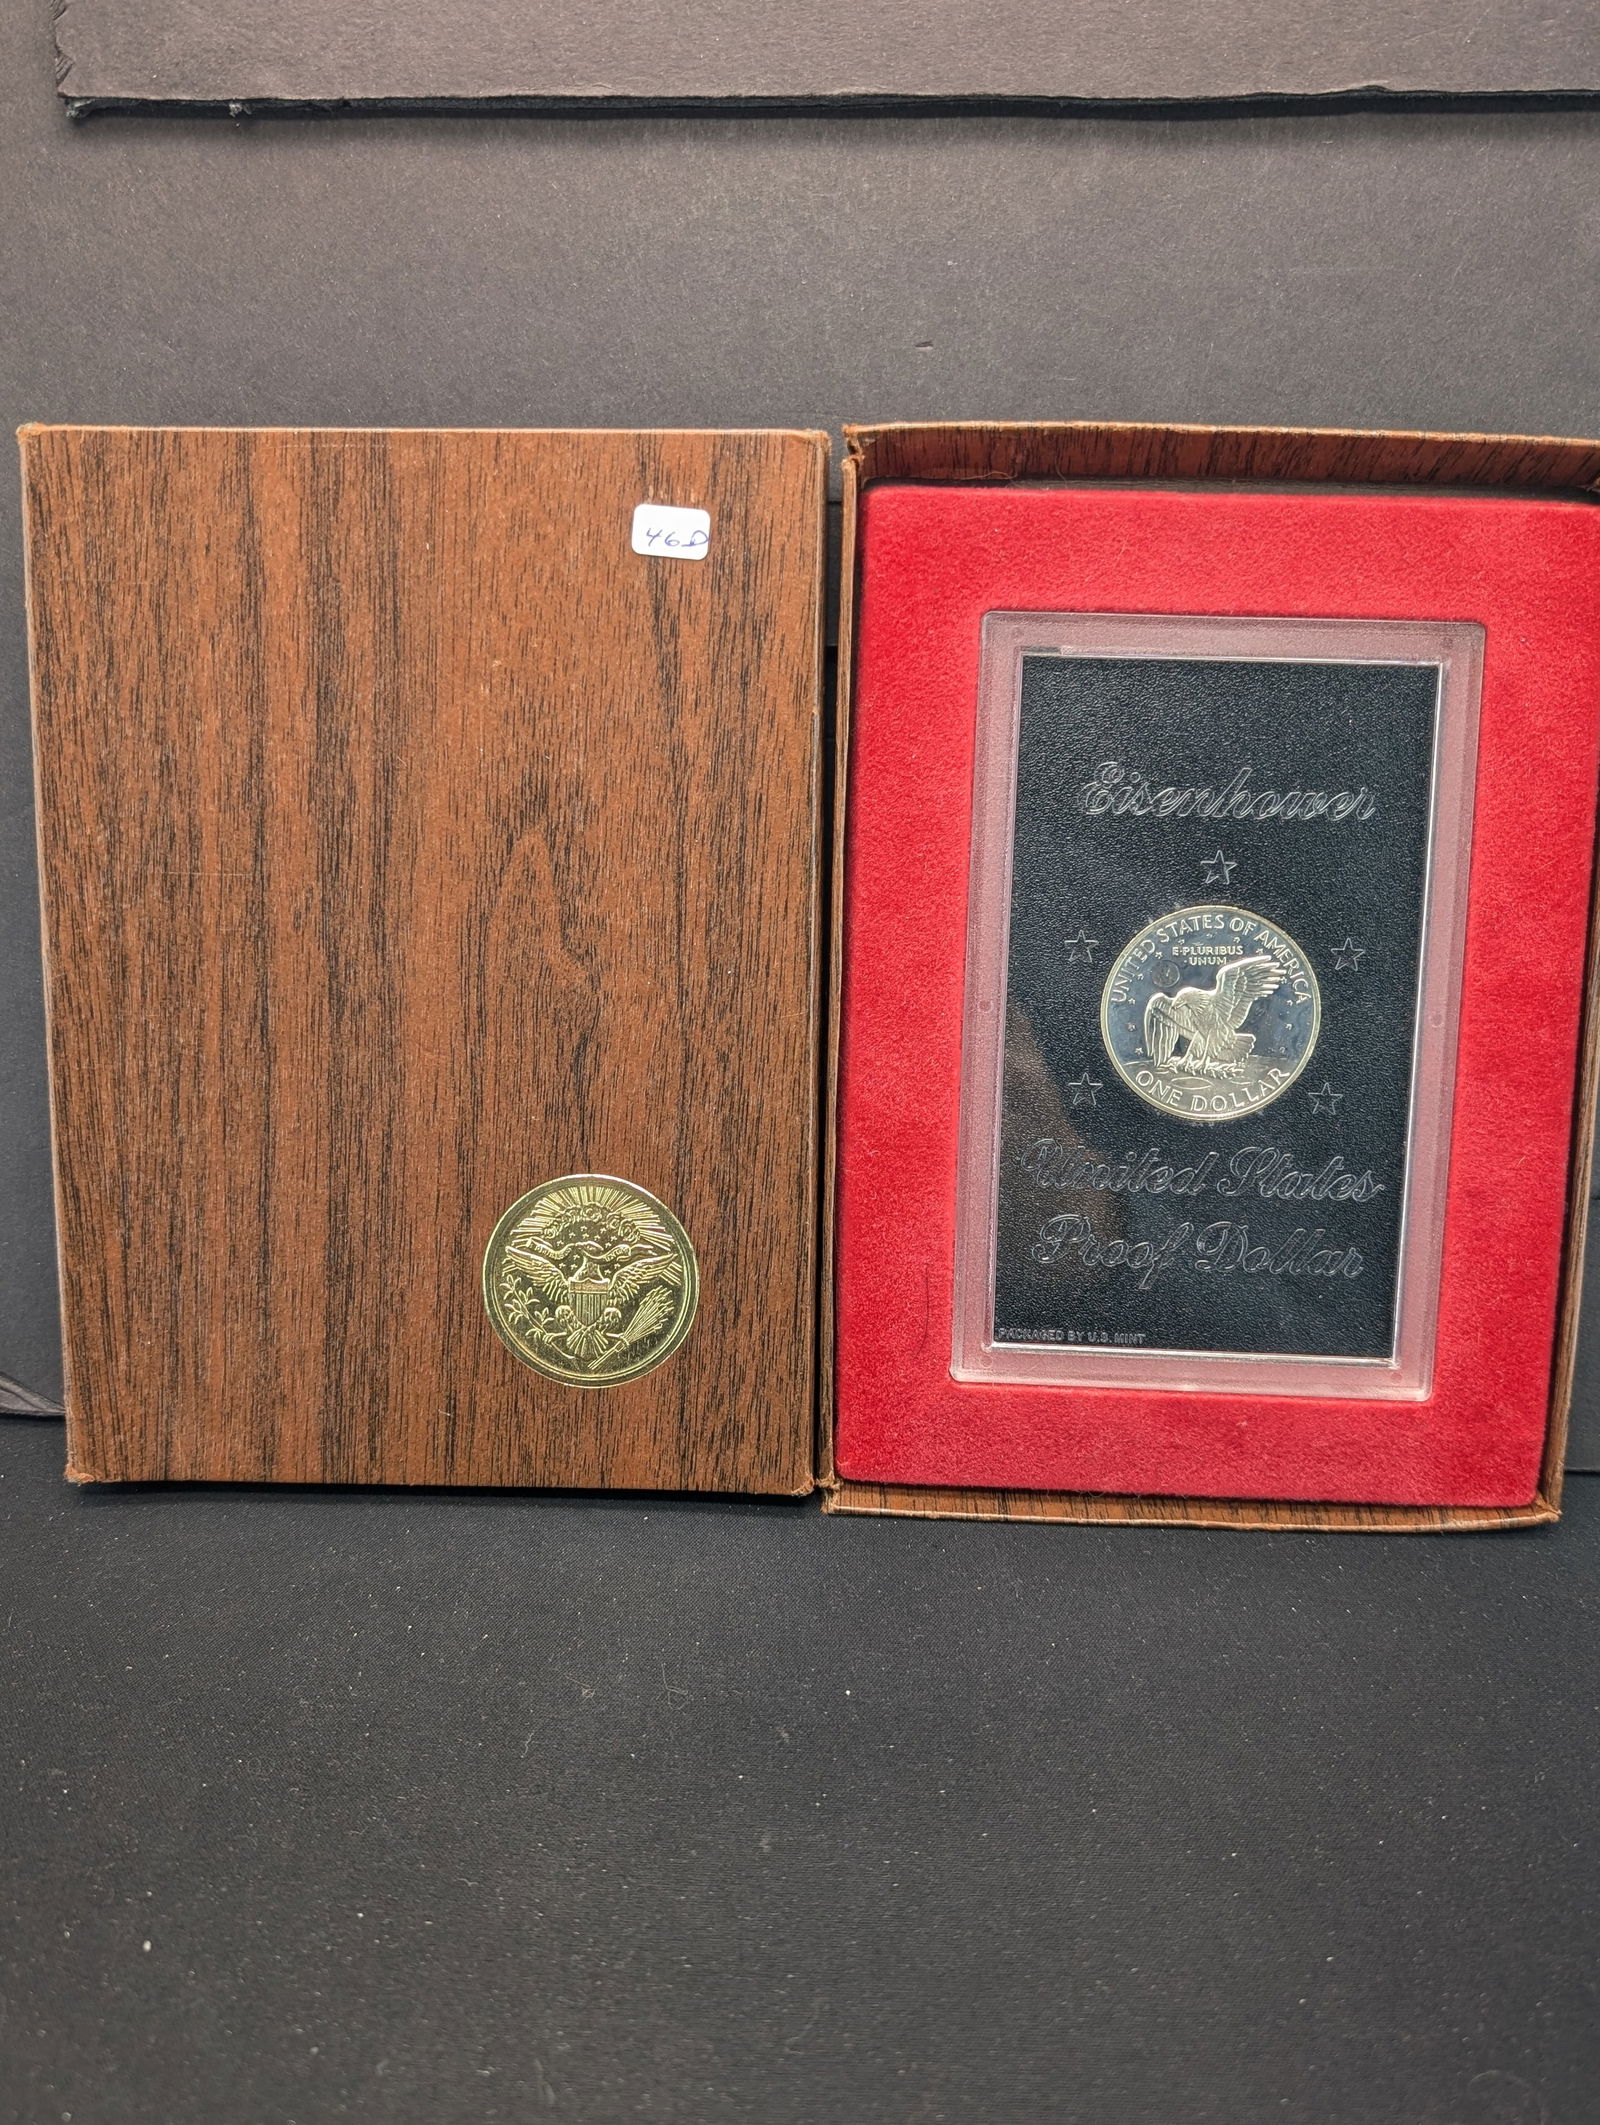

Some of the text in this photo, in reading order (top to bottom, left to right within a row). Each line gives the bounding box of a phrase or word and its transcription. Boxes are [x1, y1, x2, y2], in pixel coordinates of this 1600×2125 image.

[1078, 761, 1376, 821] Eisenhower
[1110, 914, 1312, 1004] UNITED STATES OF AMERICA
[1135, 1067, 1291, 1112] ONE DOLLAR
[1020, 1138, 1385, 1202] United States
[1031, 1214, 1365, 1290] Proof Dollar
[998, 1327, 1065, 1341] PACKAGED
[1067, 1329, 1085, 1342] BY
[1114, 1332, 1146, 1344] MINT
